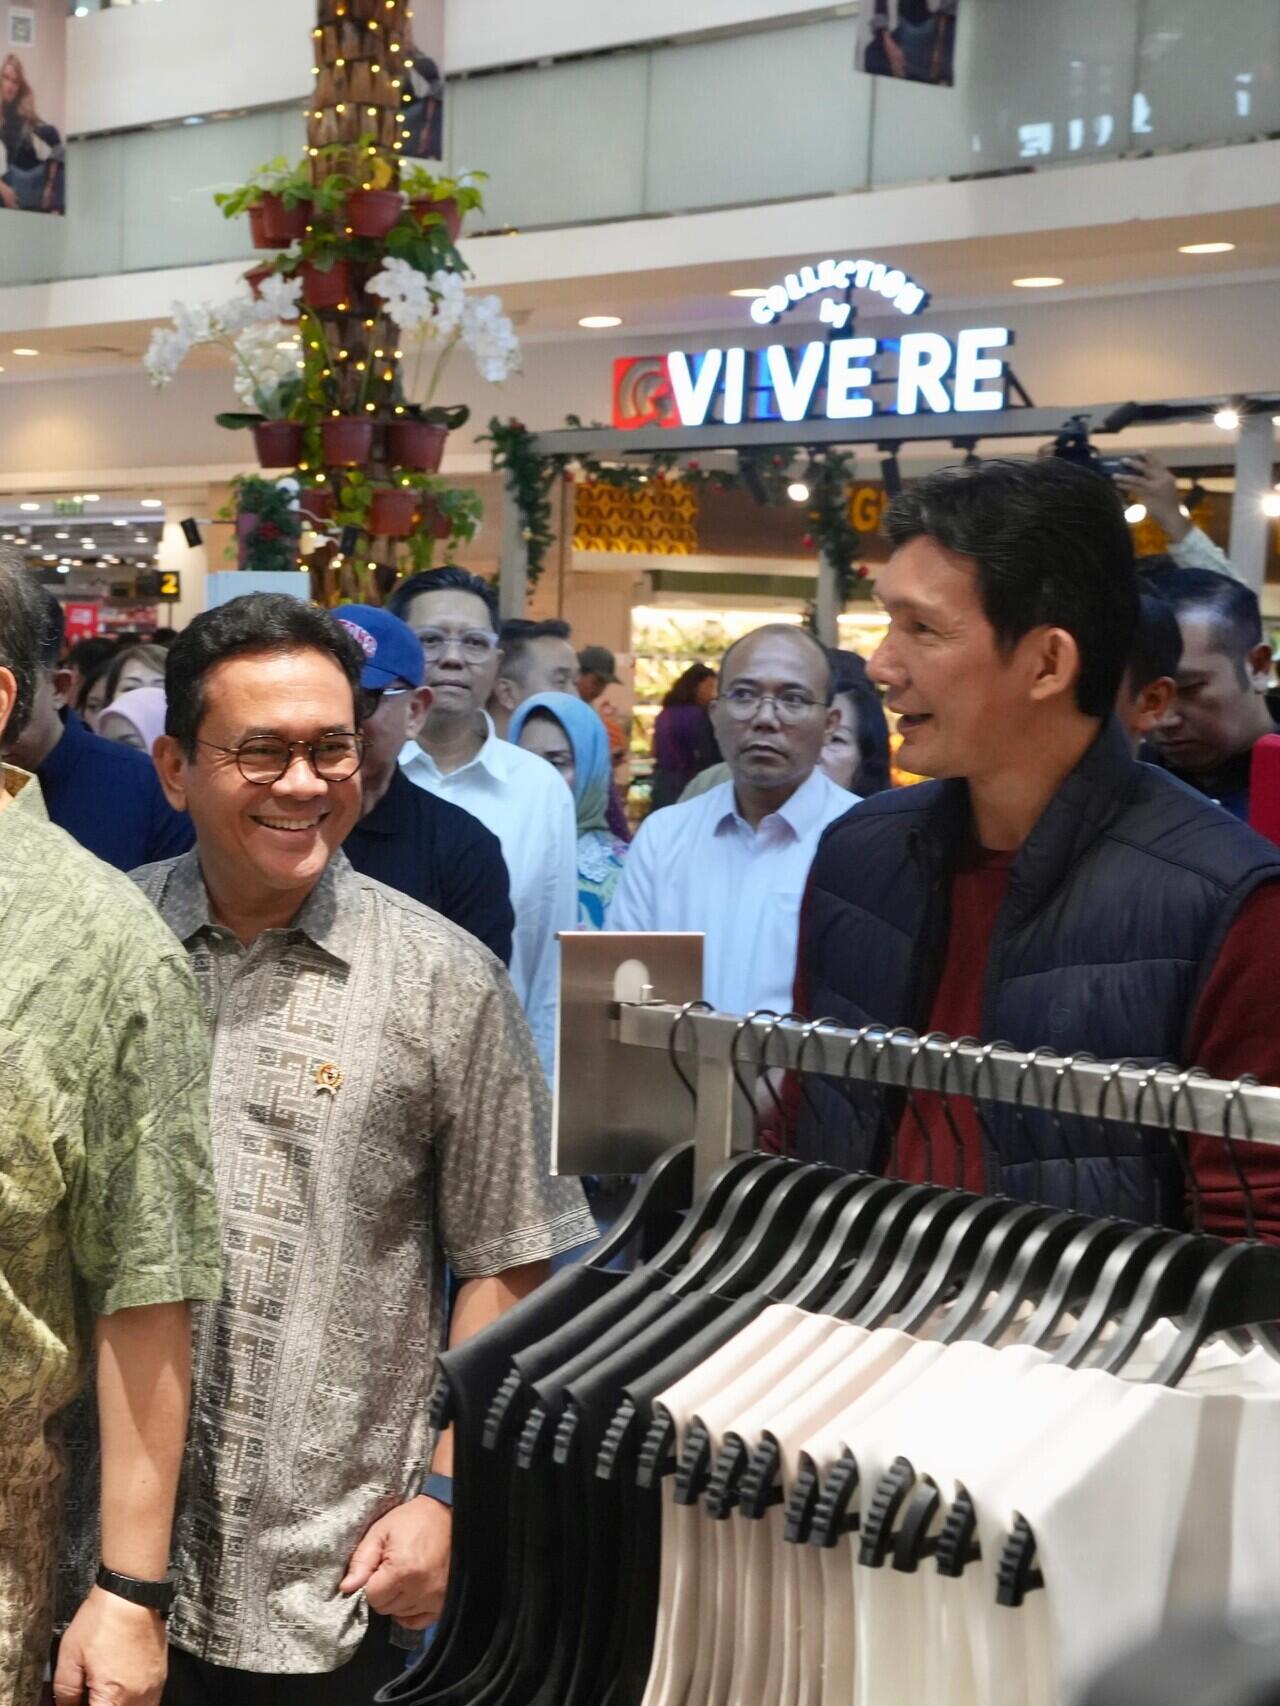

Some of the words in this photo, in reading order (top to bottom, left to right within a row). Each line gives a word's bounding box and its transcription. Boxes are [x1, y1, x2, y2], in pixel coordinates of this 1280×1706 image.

[750, 260, 924, 324] COLLECTION
[819, 299, 851, 328] by
[669, 328, 1008, 425] VIVERE
[161, 574, 177, 594] 2
